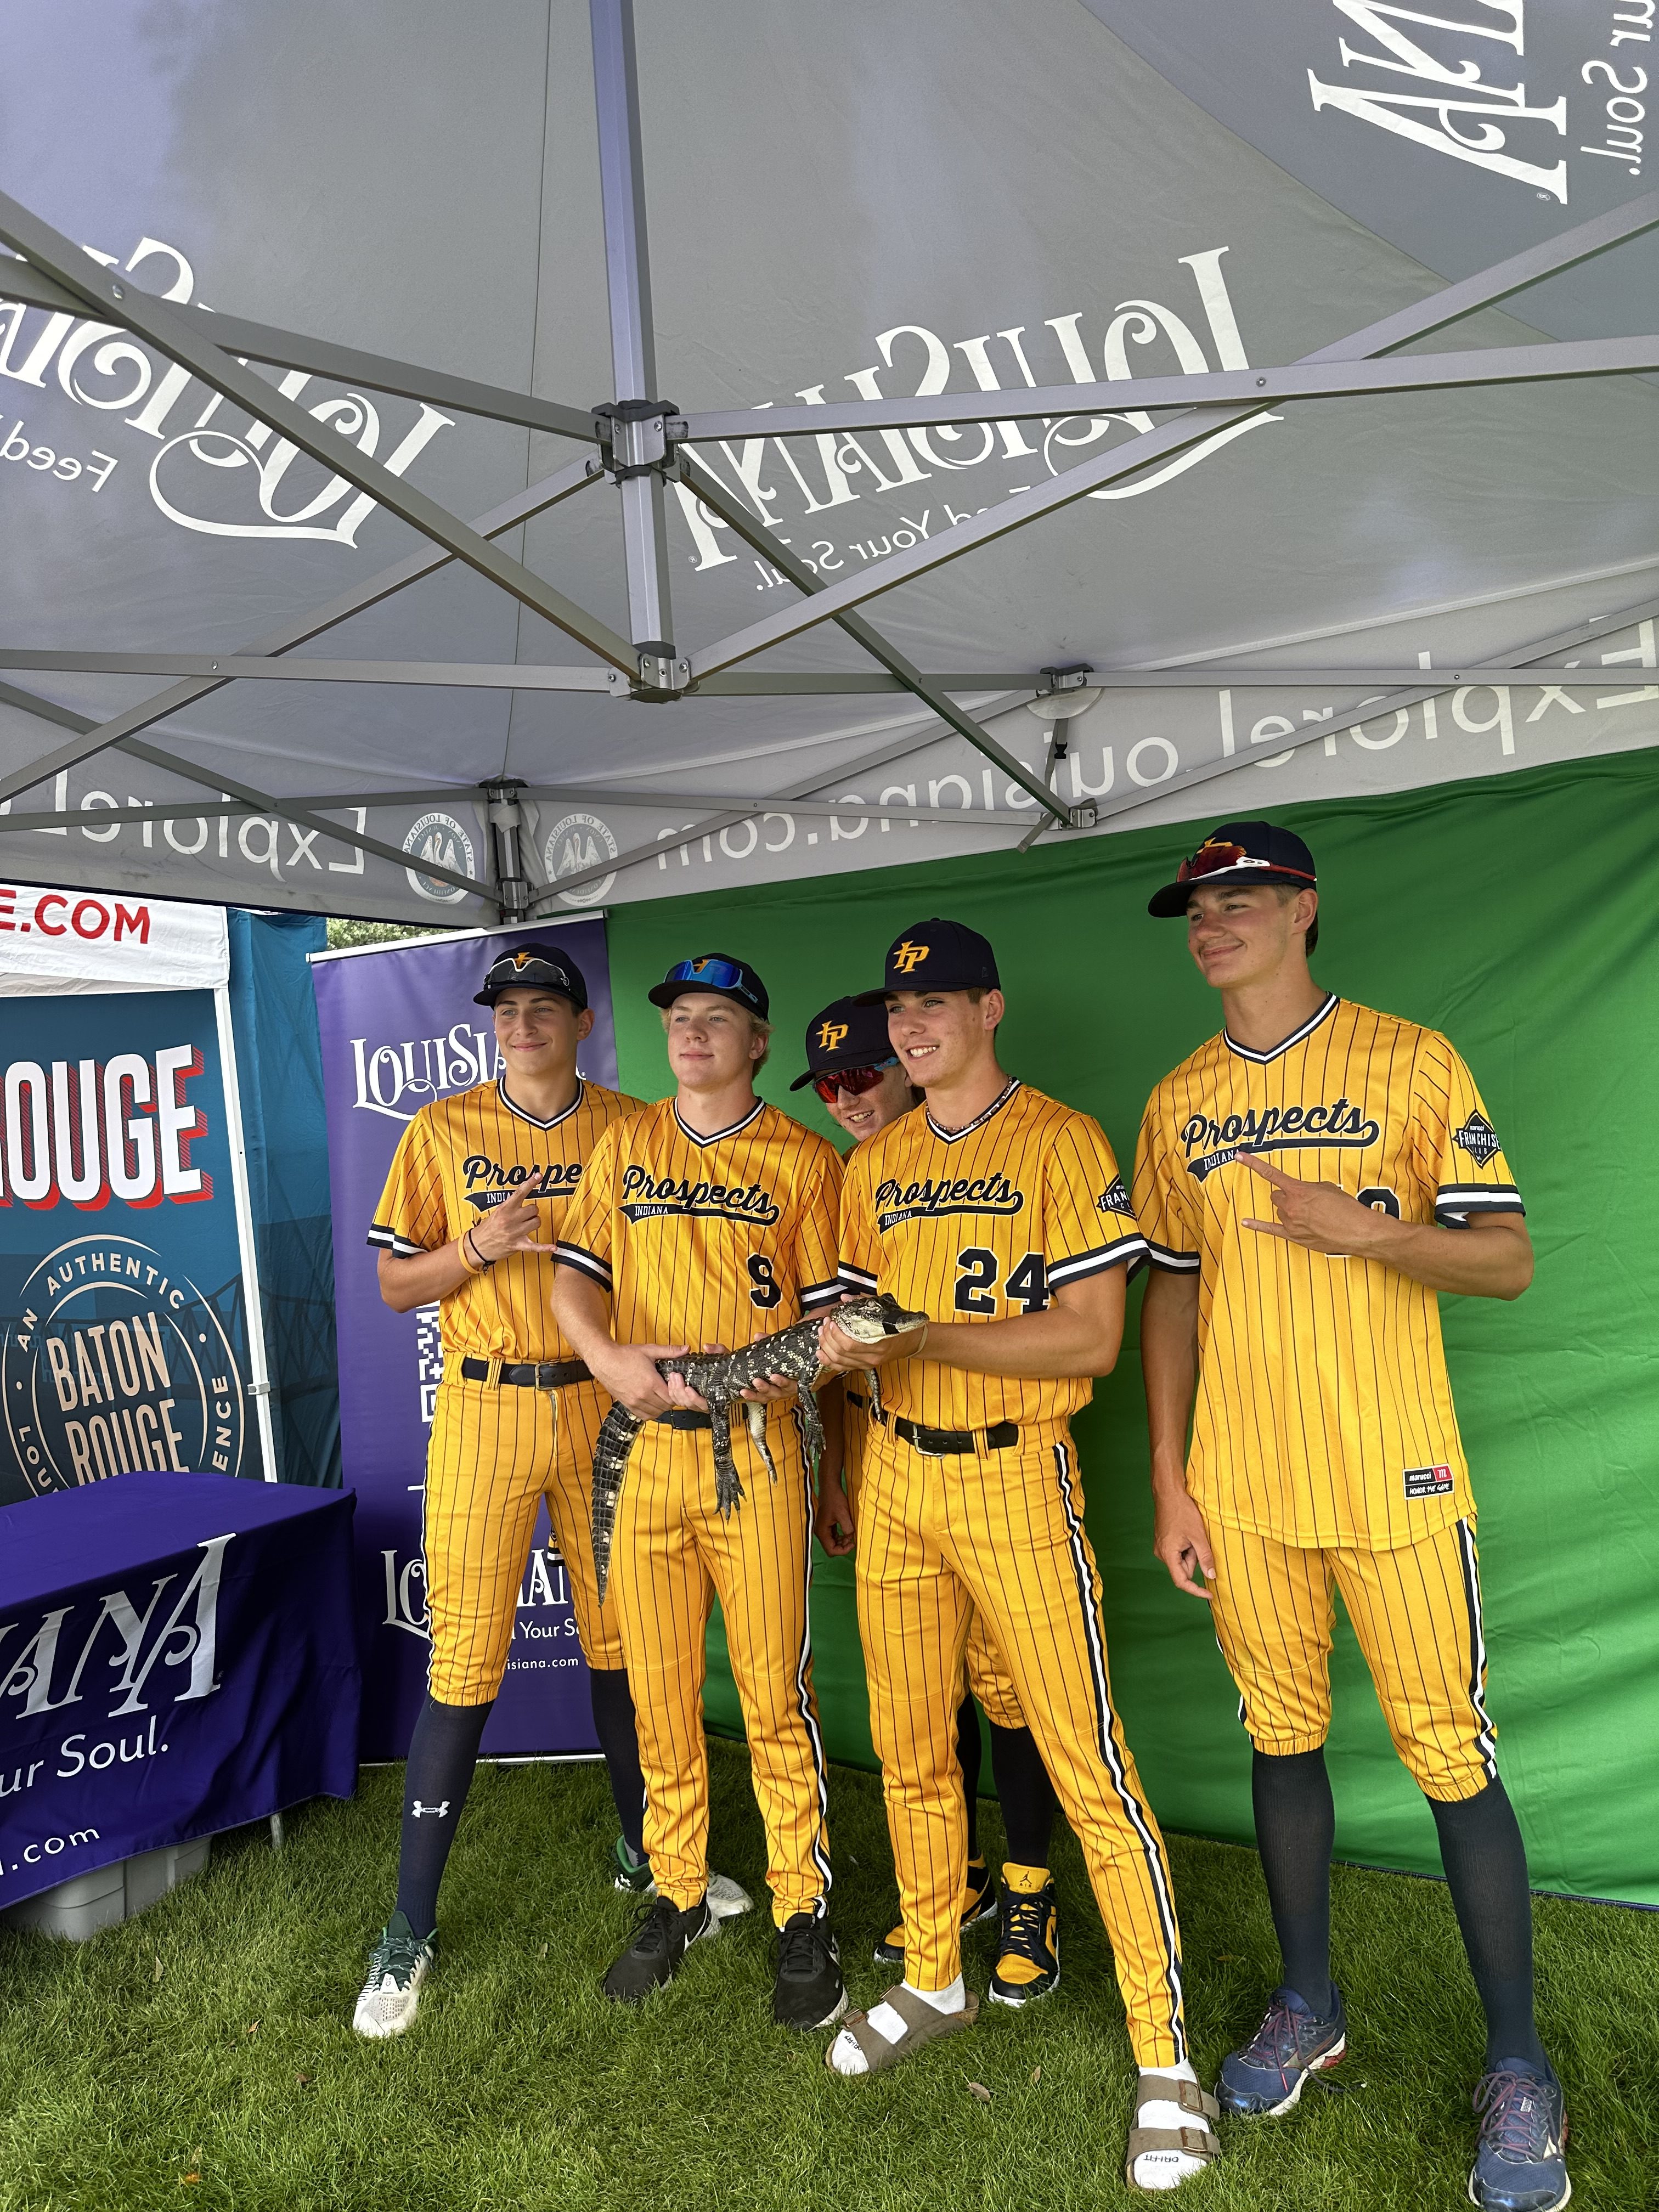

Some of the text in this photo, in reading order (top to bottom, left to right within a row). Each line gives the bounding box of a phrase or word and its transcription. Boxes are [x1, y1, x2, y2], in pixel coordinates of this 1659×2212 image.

[0, 1044, 211, 1209] OUGE
[1181, 1098, 1369, 1158] Prospects
[462, 1155, 585, 1193] Prospe
[486, 1191, 515, 1204] INDIA
[622, 1165, 776, 1216] Prospects
[874, 1171, 1015, 1213] Prospects
[634, 1205, 669, 1216] INDIANA
[884, 1209, 912, 1226] INDIANA
[1100, 1190, 1130, 1211] FRAN
[17, 1252, 185, 1352] AN AUTHENTIC
[746, 1252, 783, 1310] 9
[953, 1246, 1051, 1315] 24
[46, 1311, 171, 1412] BATON
[64, 1398, 190, 1487] ROUGE
[211, 1375, 233, 1472] ENCE
[19, 1425, 59, 1493] LOU
[1409, 1471, 1432, 1482] marucci
[519, 1621, 560, 1639] Your
[507, 1658, 579, 1670] isiana.com
[0, 1715, 168, 1797] ur Soul.
[0, 1828, 100, 1876] .com
